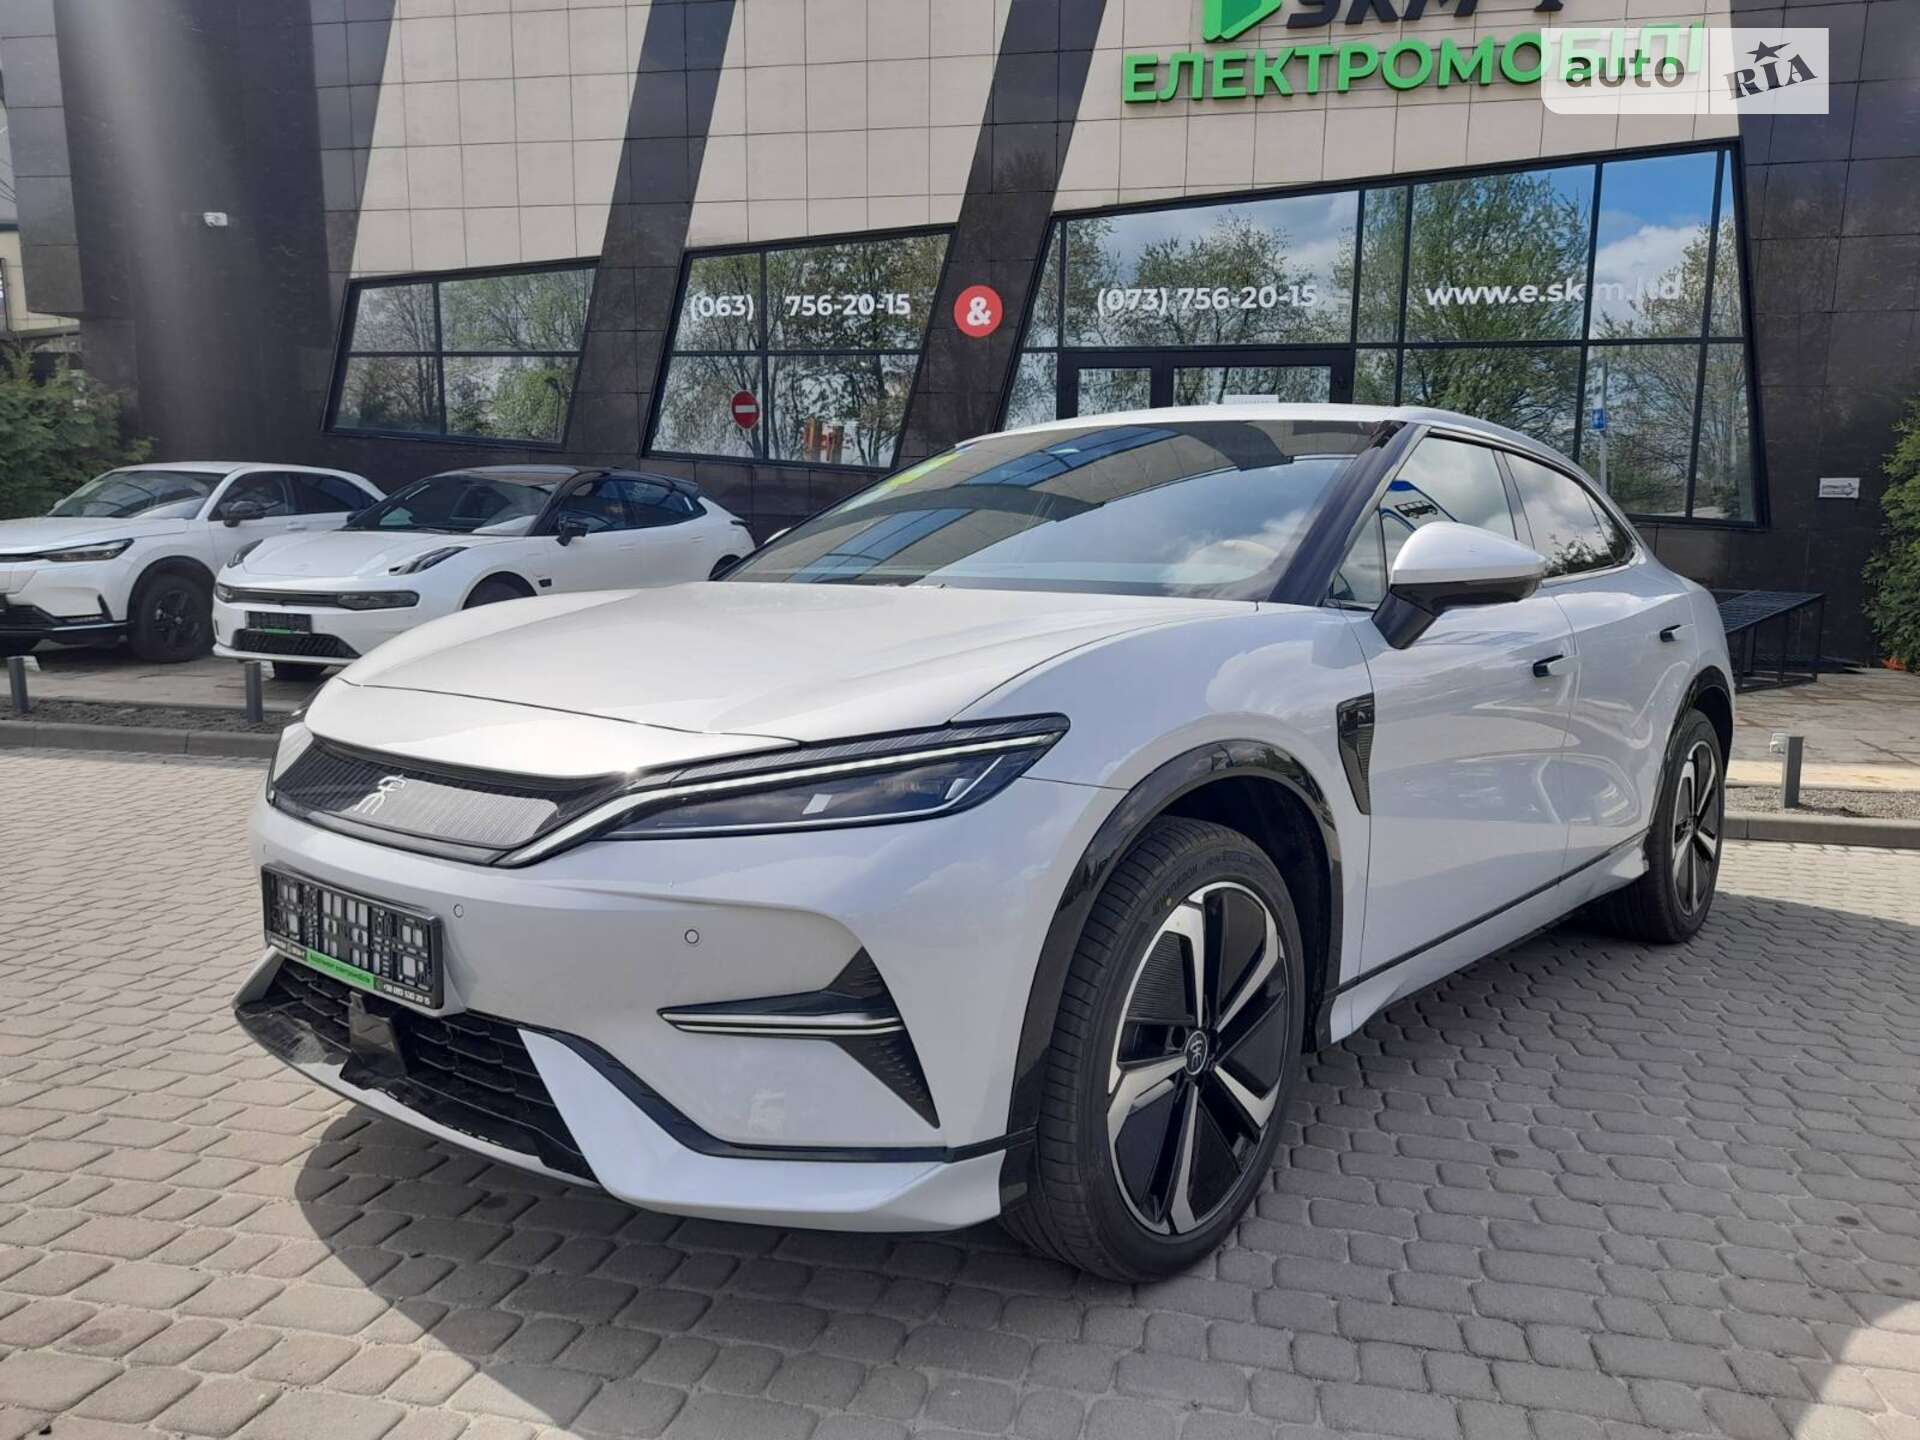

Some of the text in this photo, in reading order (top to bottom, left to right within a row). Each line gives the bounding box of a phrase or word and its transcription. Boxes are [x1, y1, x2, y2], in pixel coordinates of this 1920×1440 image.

[689, 292, 912, 322] (063) 756-20-15
[1097, 284, 1317, 316] (073) 756-20-15
